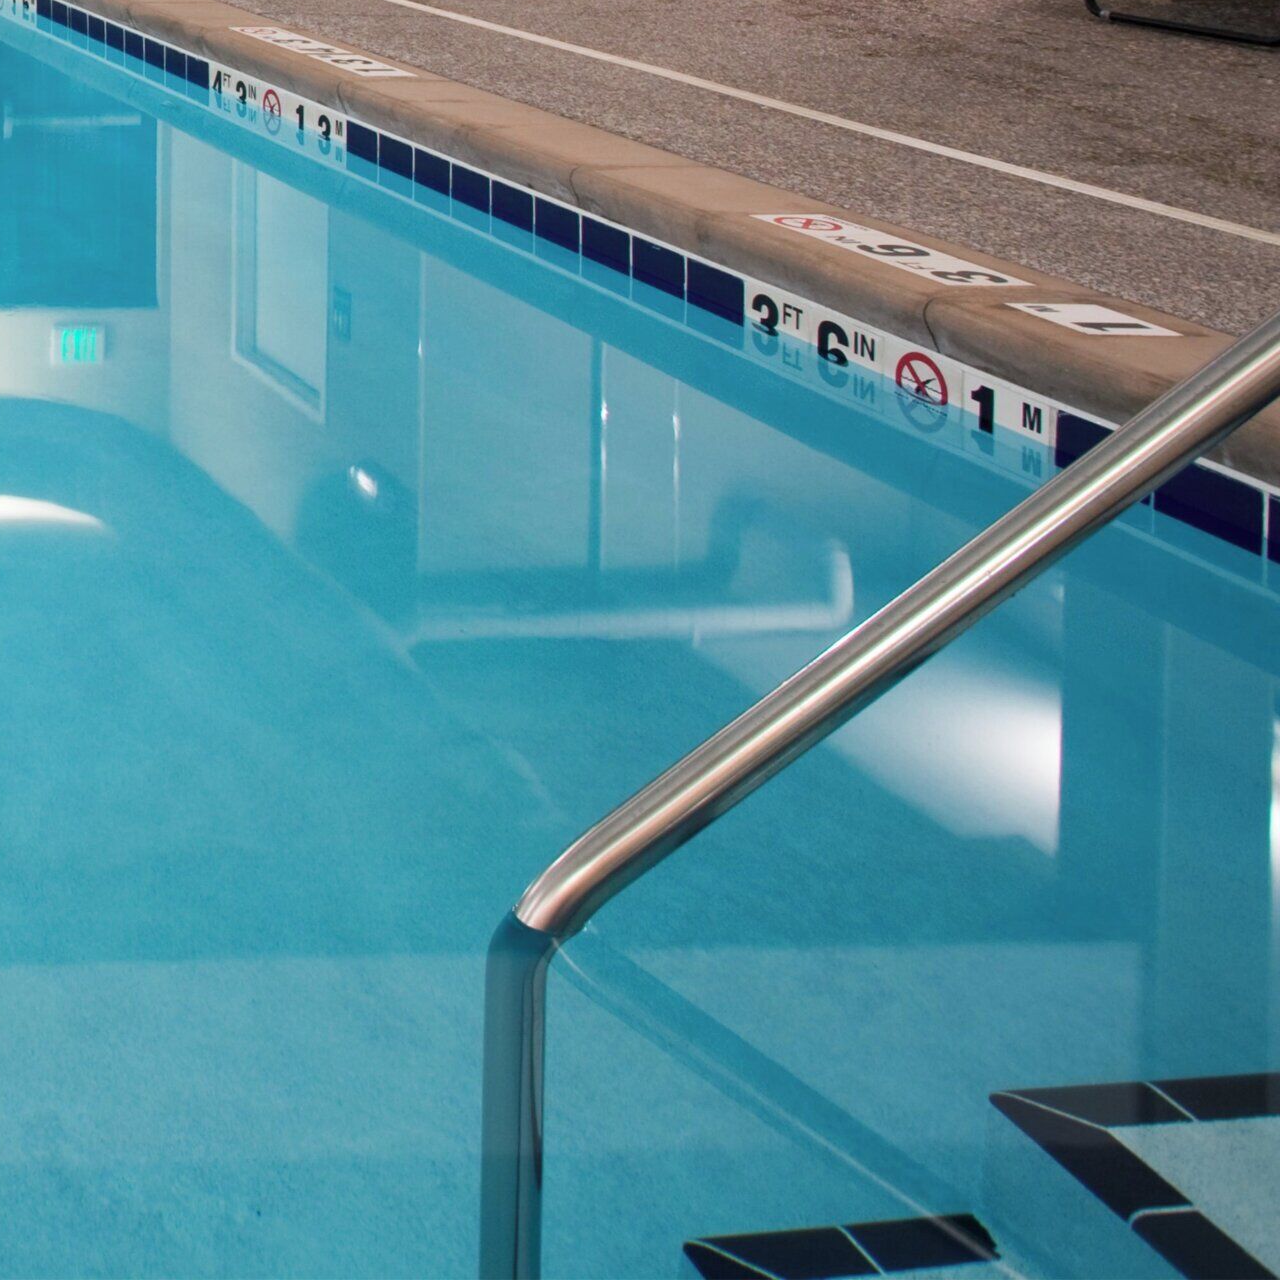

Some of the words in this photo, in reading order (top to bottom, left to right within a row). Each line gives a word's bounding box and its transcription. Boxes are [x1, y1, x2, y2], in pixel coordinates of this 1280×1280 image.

[212, 70, 223, 94] 4
[223, 73, 232, 88] FT
[236, 80, 247, 105] 3
[248, 84, 257, 100] IN
[335, 119, 343, 137] M
[856, 243, 931, 257] 6
[929, 270, 1010, 283] 3
[1069, 322, 1153, 332] 1
[751, 293, 780, 336] 3
[782, 302, 803, 331] FT
[817, 319, 850, 367] 6
[853, 330, 876, 362] IN
[969, 384, 995, 435] 1
[1021, 401, 1042, 434] M
